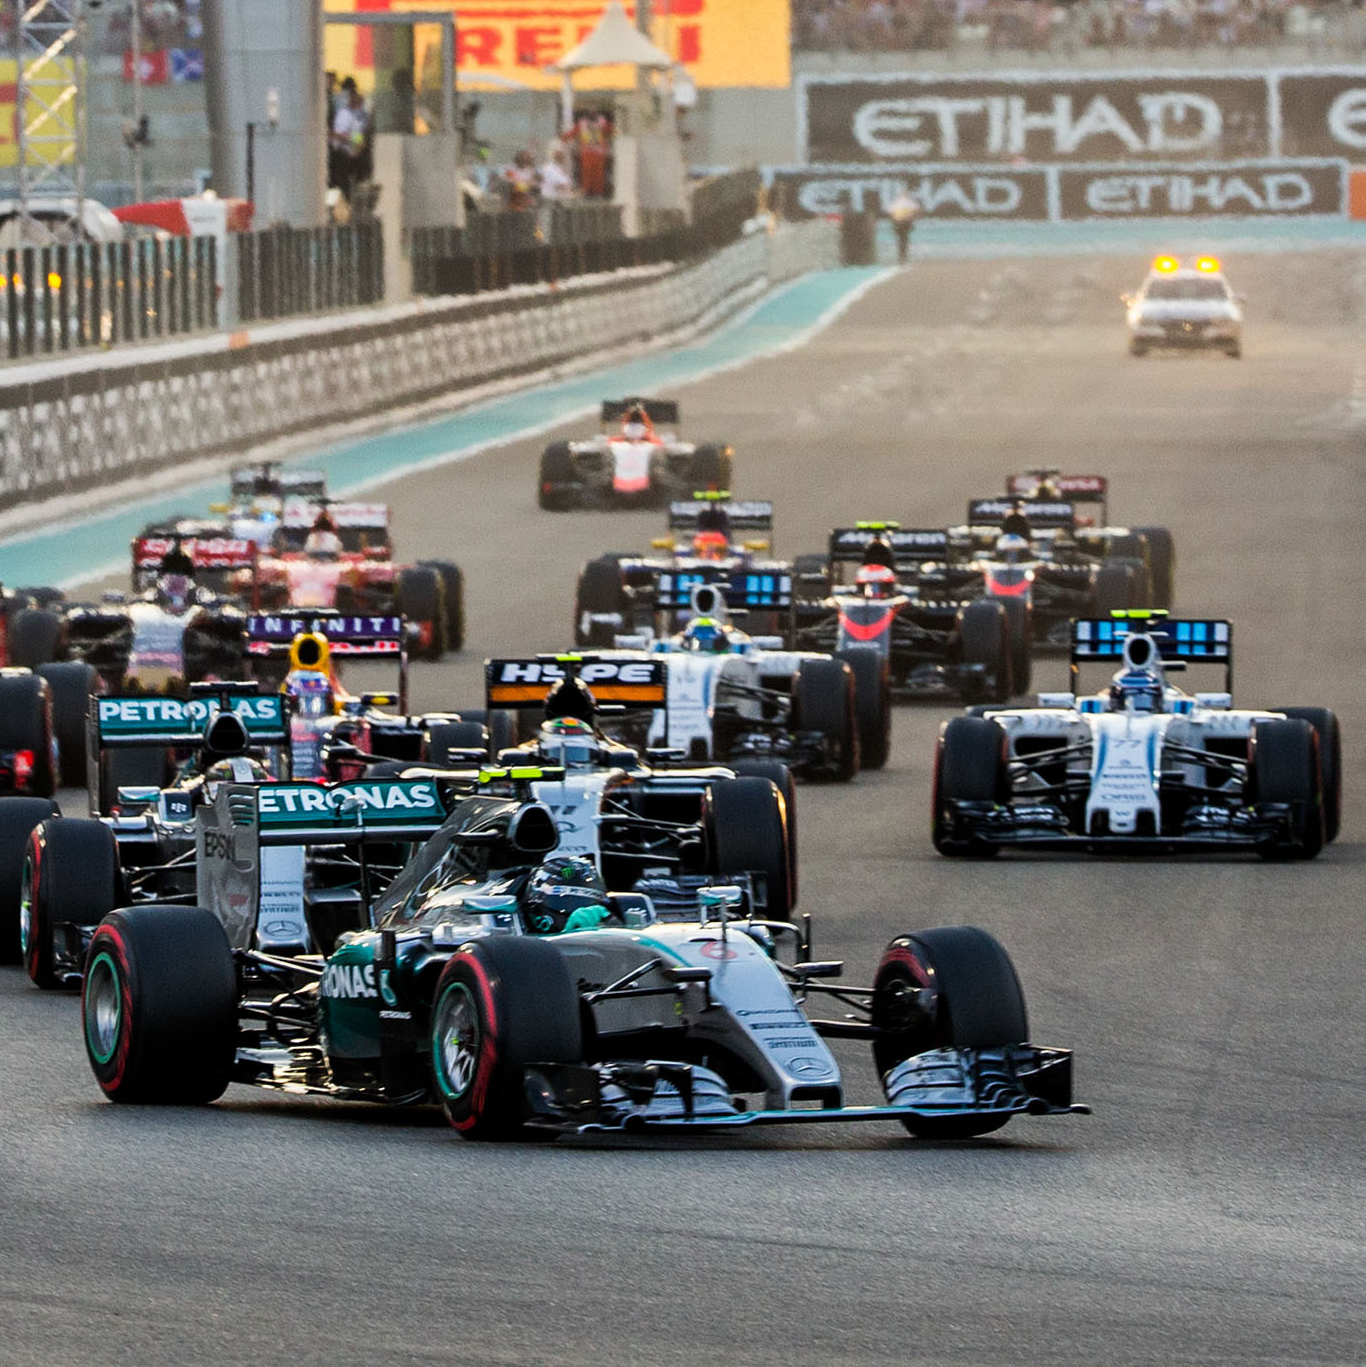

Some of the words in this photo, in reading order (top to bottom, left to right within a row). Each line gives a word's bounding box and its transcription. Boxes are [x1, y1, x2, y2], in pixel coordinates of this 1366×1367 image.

[851, 91, 1224, 159] ETIHAD
[798, 178, 1022, 214] ETIHAD
[1085, 173, 1313, 214] ETIHAD
[258, 784, 436, 812] ETRONAS
